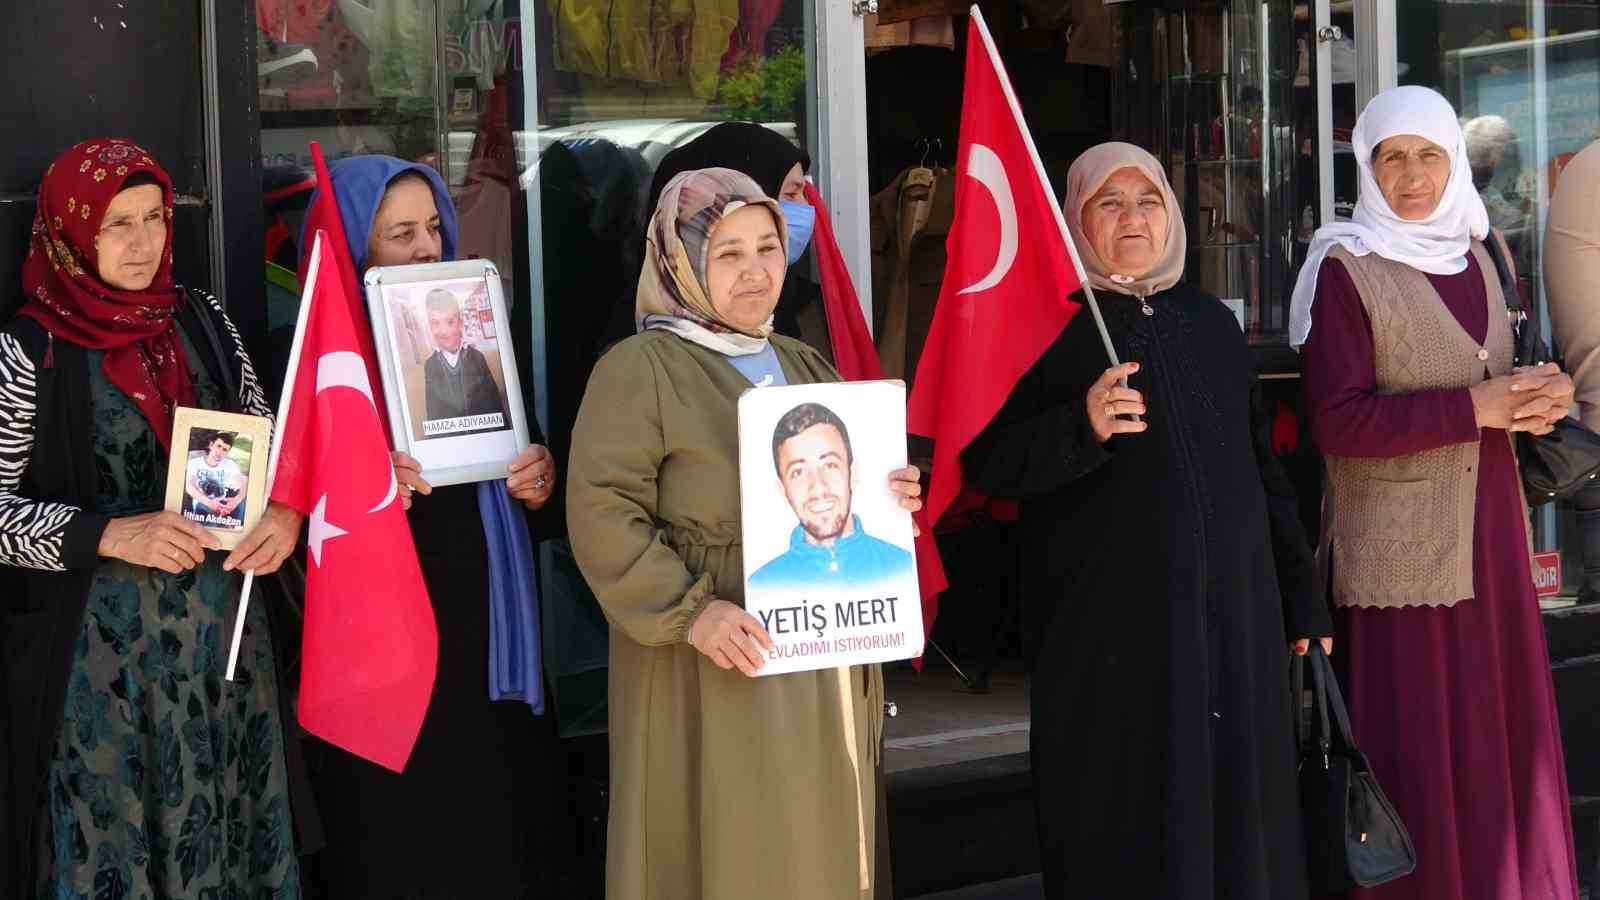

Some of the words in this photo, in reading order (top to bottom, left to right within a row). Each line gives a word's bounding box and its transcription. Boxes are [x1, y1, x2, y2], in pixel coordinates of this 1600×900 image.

[423, 419, 457, 433] HAMZA
[457, 414, 504, 428] ADIYAMAN
[758, 599, 828, 638] YETİŞ
[834, 597, 899, 629] MERT
[768, 639, 831, 660] EVLADIMI
[833, 631, 906, 654] İSTİYORUM!
